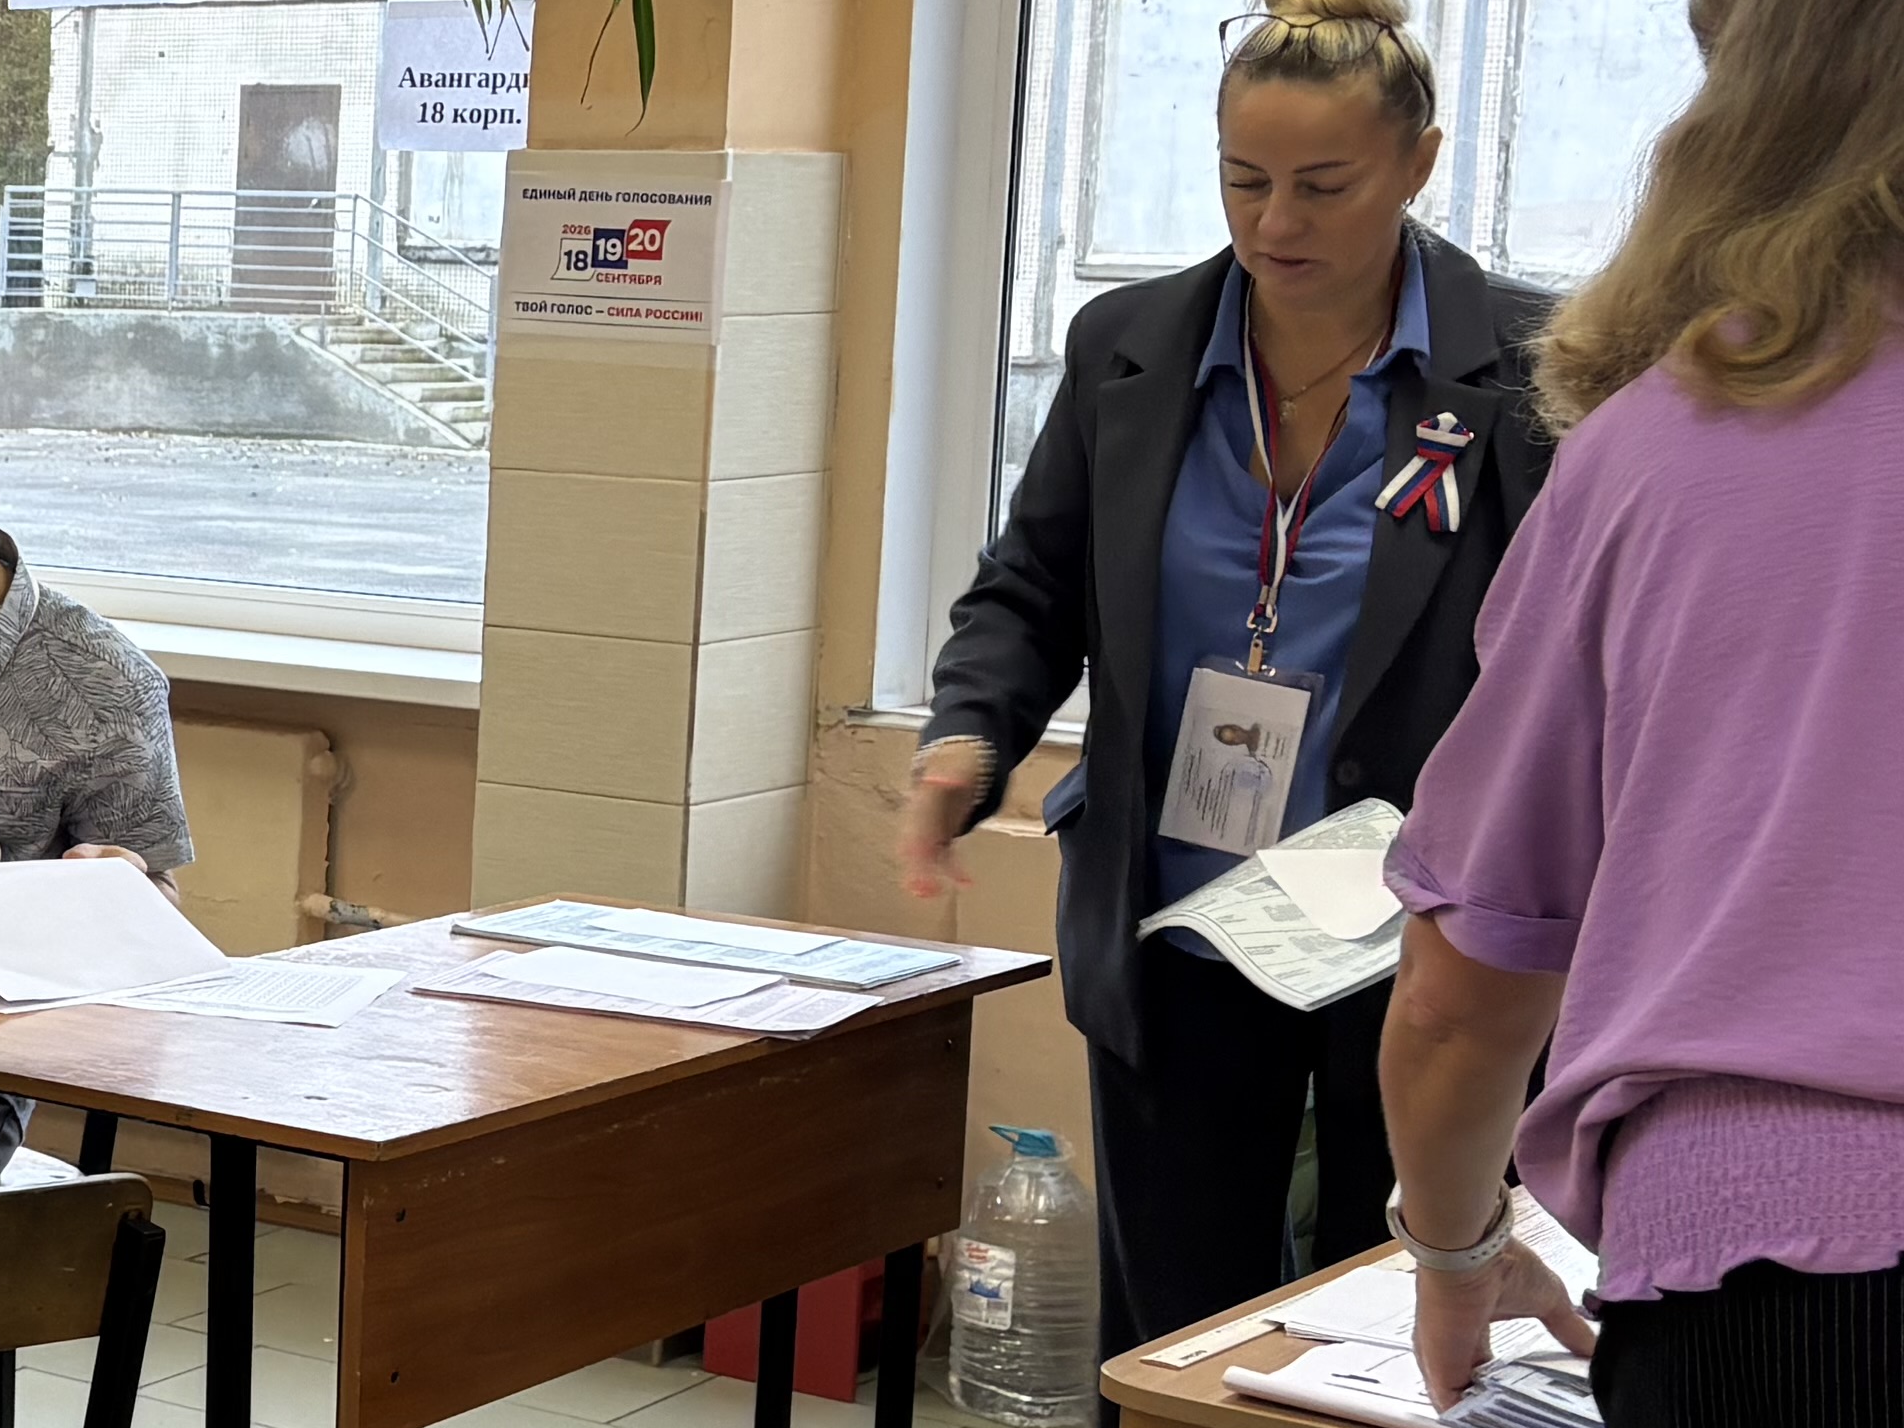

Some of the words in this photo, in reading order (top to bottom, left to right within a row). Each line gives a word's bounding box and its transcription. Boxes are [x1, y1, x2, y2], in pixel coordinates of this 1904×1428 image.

[417, 101, 445, 124] 18
[452, 107, 522, 130] корп.
[522, 188, 576, 201] ЕДИНЫЙ
[578, 190, 612, 203] ДЕНЬ
[615, 191, 712, 206] ГОЛОСОВАНИЯ
[561, 223, 591, 236] 2026
[563, 249, 589, 272] 18
[595, 237, 623, 262] 19
[627, 228, 661, 252] 20
[595, 272, 662, 286] СЕНТЯБРЯ
[515, 300, 548, 314] ТВОЙ
[550, 302, 593, 316] ГОЛОС
[607, 306, 642, 319] СИЛА
